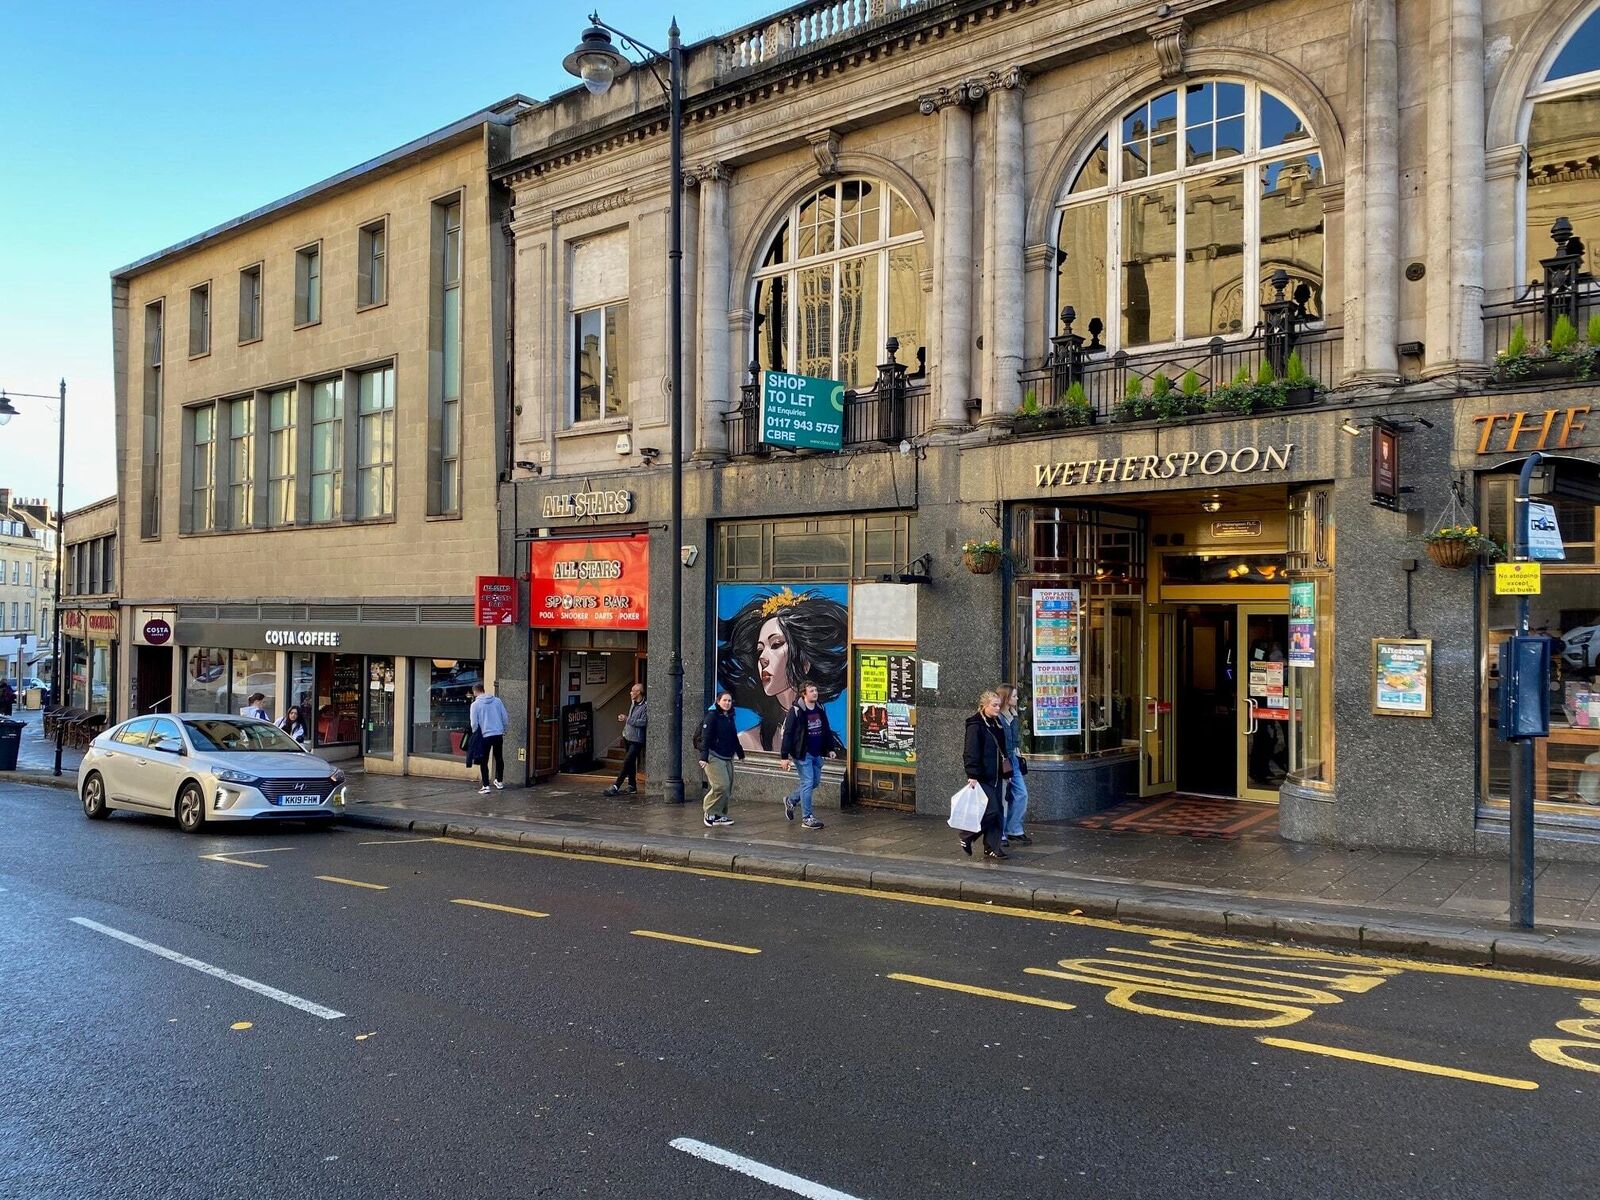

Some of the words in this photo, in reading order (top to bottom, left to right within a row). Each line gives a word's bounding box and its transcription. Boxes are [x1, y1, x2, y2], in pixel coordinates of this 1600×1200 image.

[768, 374, 806, 390] SHOP
[767, 389, 786, 404] TO
[790, 392, 815, 407] LET
[767, 405, 776, 413] All
[777, 406, 807, 416] Enquiries
[767, 416, 790, 428] 0117
[793, 419, 814, 431] 943
[815, 422, 840, 434] 5757
[766, 429, 796, 441] CBRE
[1033, 443, 1294, 488] WETHERSPOON
[543, 494, 574, 518] ALL
[575, 490, 629, 517] STARS
[553, 561, 578, 579] ALL
[578, 560, 621, 579] STARS
[545, 594, 598, 609] SPORTS
[603, 594, 630, 609] BAR
[540, 611, 554, 619] POOL
[561, 612, 589, 620] SNOOKER
[595, 612, 613, 620] DARTS
[620, 612, 640, 620] POKER
[265, 630, 295, 646] COSTA
[297, 631, 337, 646] COFFEE
[1381, 646, 1425, 656] Afternoon
[1391, 653, 1414, 661] deals
[568, 711, 588, 722] SHOTS
[285, 796, 302, 804] KK19
[1023, 939, 1403, 1028] STOP
